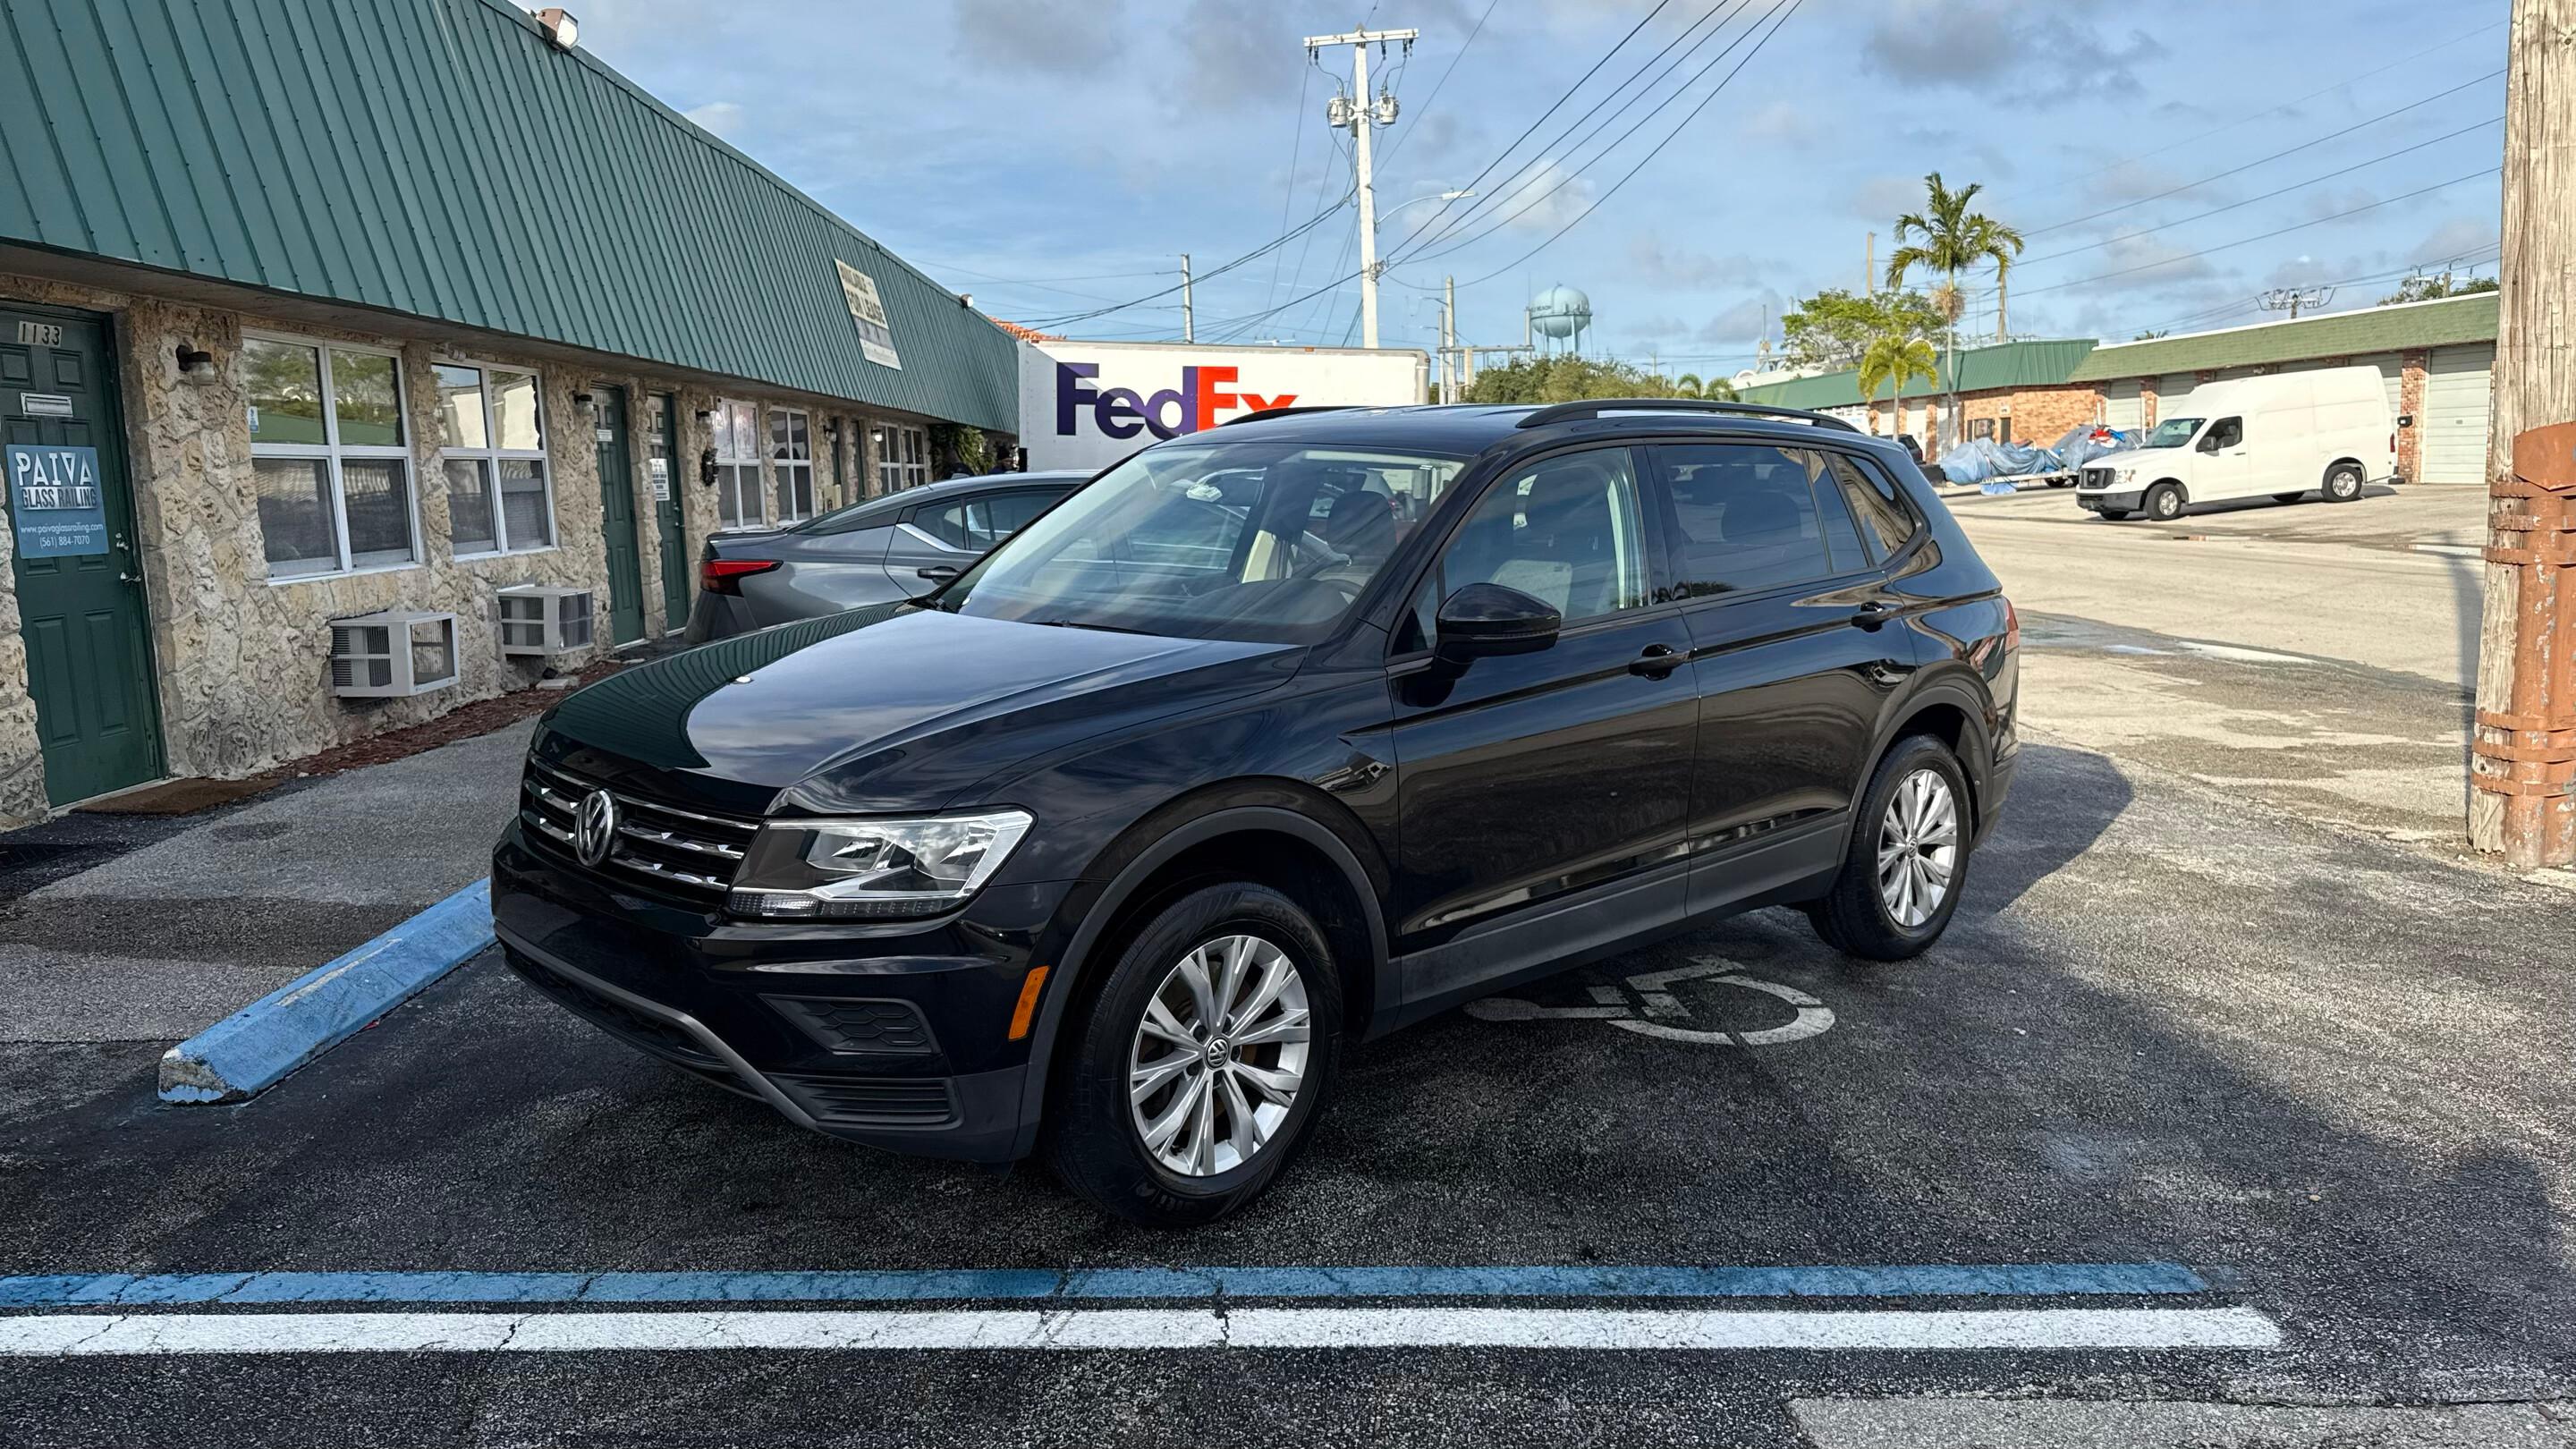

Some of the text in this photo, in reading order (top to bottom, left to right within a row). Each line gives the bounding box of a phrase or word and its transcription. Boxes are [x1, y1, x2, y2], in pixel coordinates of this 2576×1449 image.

[22, 323, 60, 345] 1133
[15, 452, 94, 486] PAIVA
[21, 488, 97, 508] GLASS RAILING
[40, 535, 90, 548] (561) 884-7070
